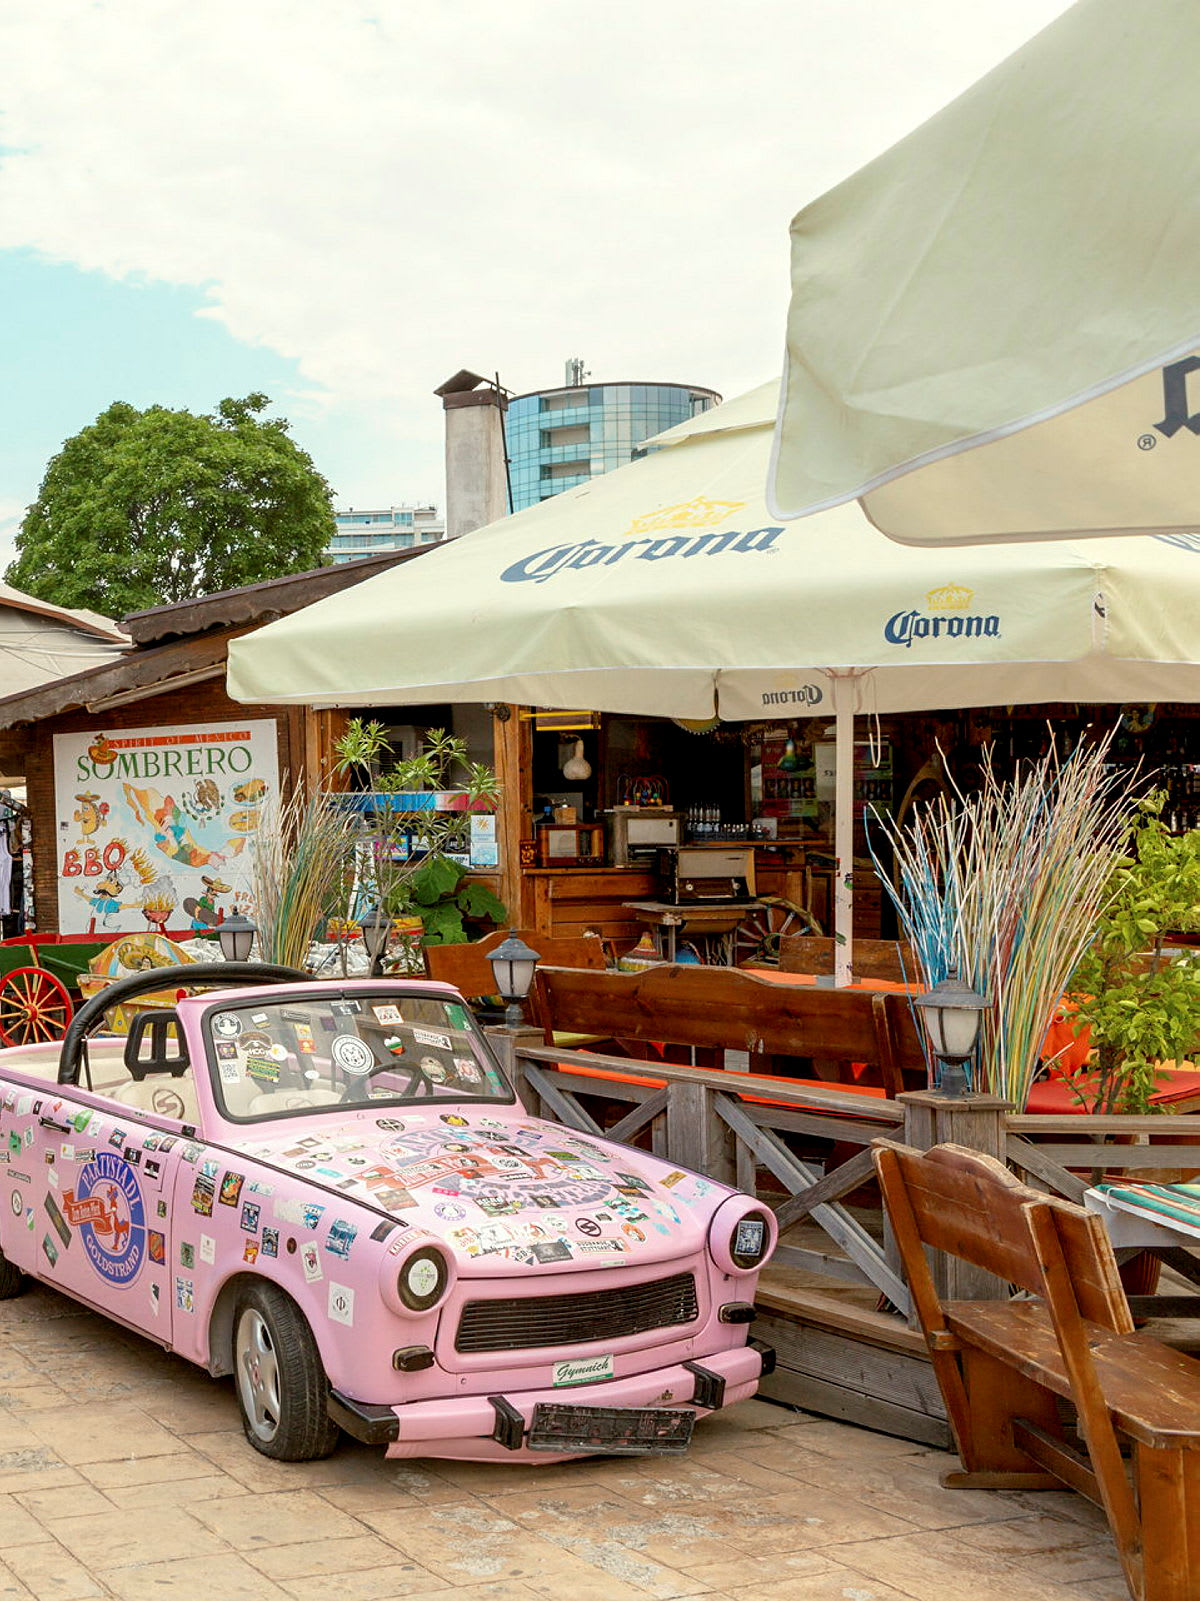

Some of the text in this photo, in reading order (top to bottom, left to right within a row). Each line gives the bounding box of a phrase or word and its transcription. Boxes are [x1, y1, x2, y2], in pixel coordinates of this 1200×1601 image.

[500, 527, 786, 583] Corona
[885, 610, 999, 648] Corona
[114, 731, 249, 749] SPIRIT OF MEXICO
[77, 746, 252, 782] SOMBRERO
[62, 841, 126, 877] BBQ
[82, 1154, 140, 1211] PARTYSTADL
[86, 1234, 140, 1278] GOLDSTRAND
[557, 1357, 609, 1381] Gymnich
